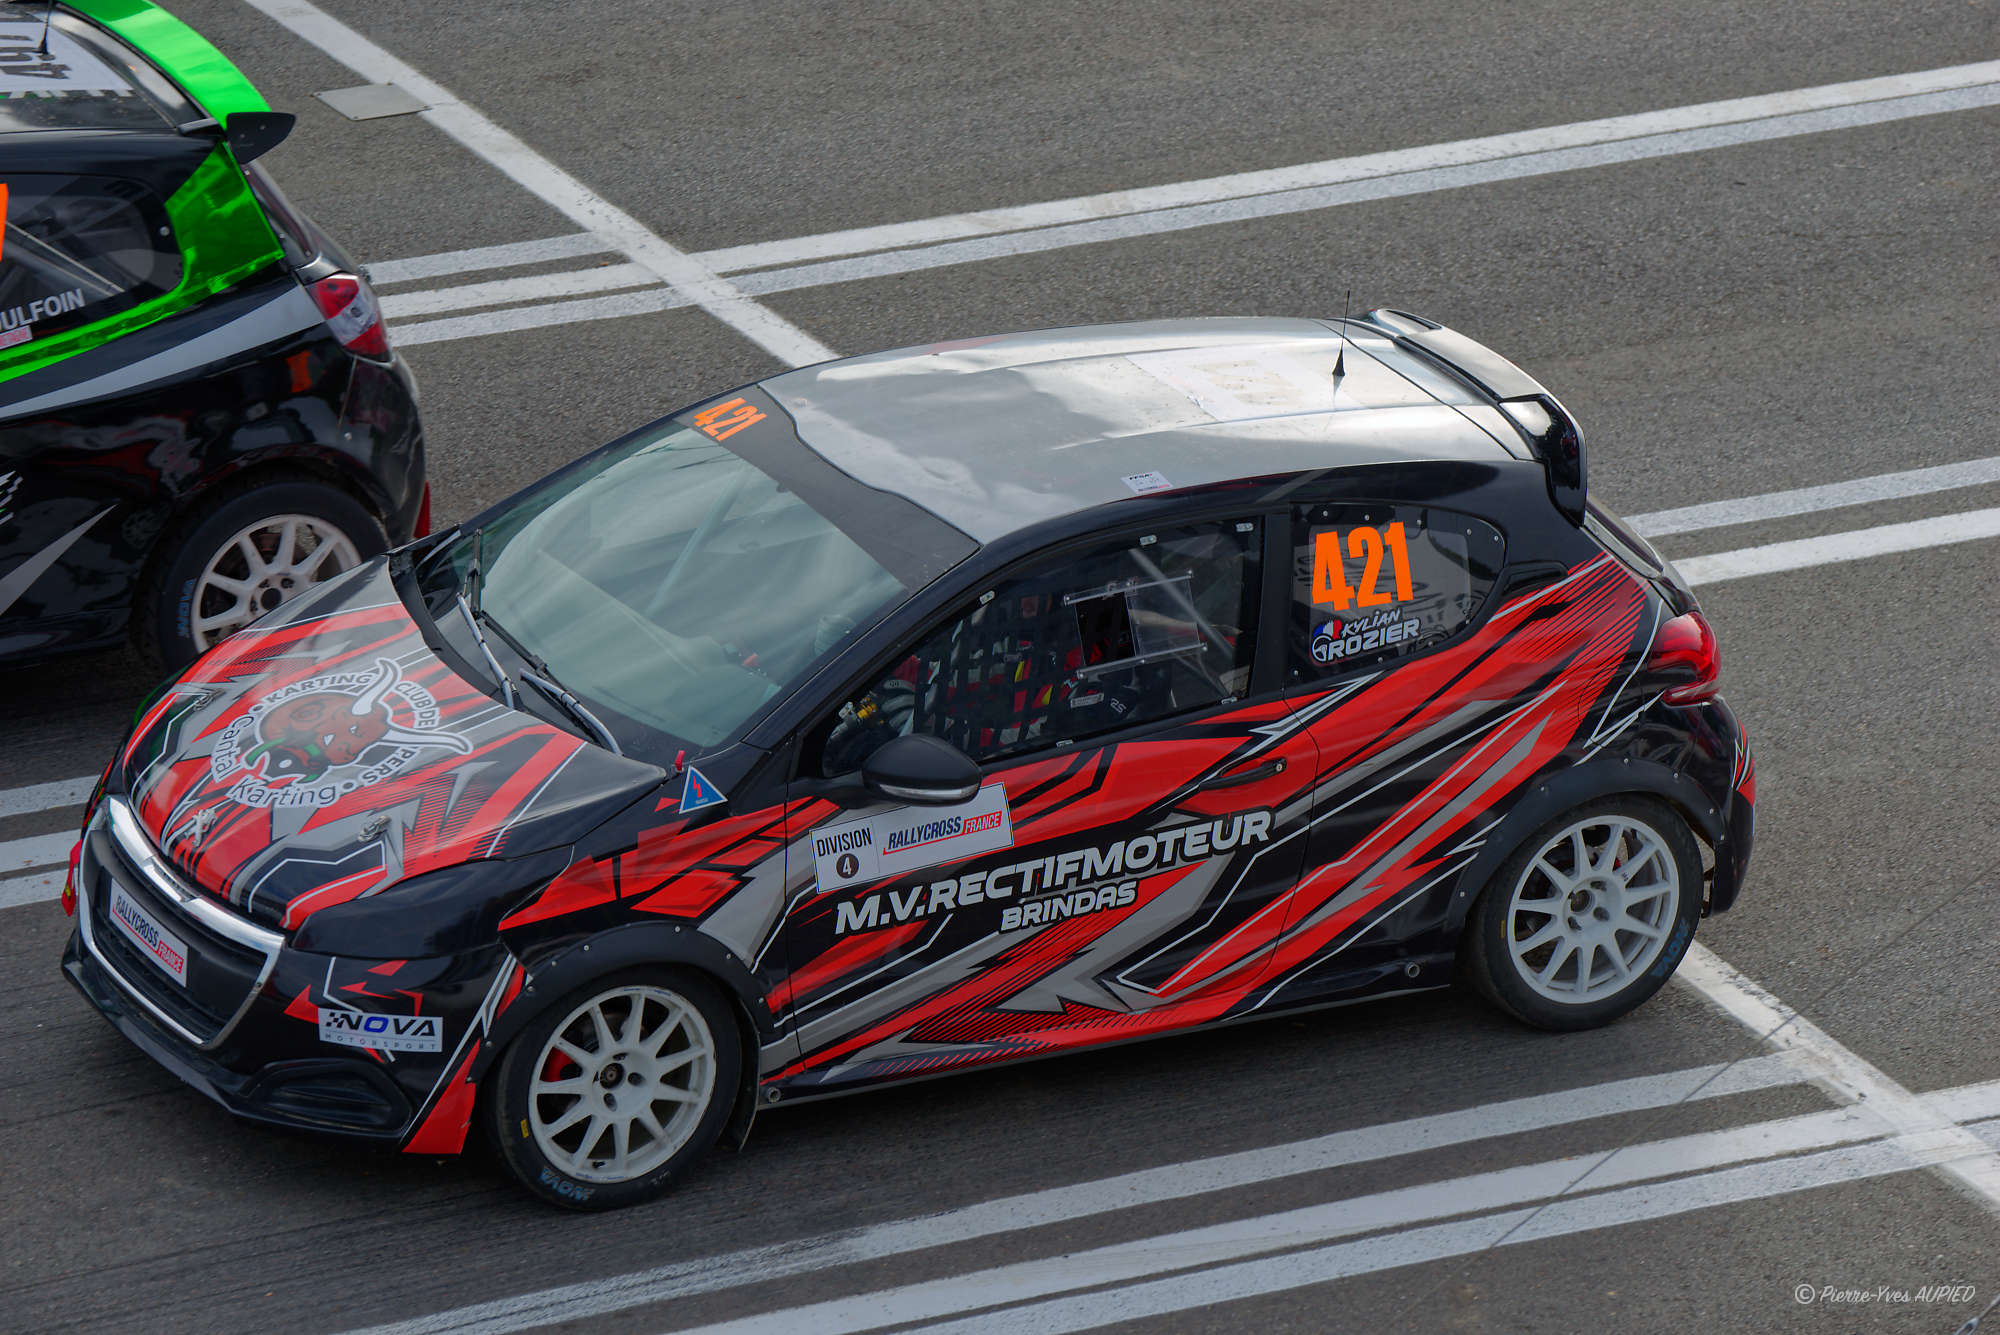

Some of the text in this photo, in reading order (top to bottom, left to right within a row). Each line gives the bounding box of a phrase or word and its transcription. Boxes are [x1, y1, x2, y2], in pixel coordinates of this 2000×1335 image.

[0, 287, 86, 332] ULFOIN
[693, 397, 767, 442] 421
[1311, 521, 1414, 611] 421
[1327, 618, 1420, 661] ROZIER
[268, 673, 435, 783] KARTING CLUB DE PERS
[215, 716, 337, 806] Cantal Karting
[816, 827, 872, 857] DIVISION
[887, 812, 1001, 850] RALLYCROSS FRANCE
[842, 857, 852, 875] 4
[115, 895, 160, 948] RALLYCROSS
[1001, 881, 1138, 932] BRINDAS
[325, 1033, 437, 1050] MOTORSPORT
[335, 1013, 435, 1037] NOVA
